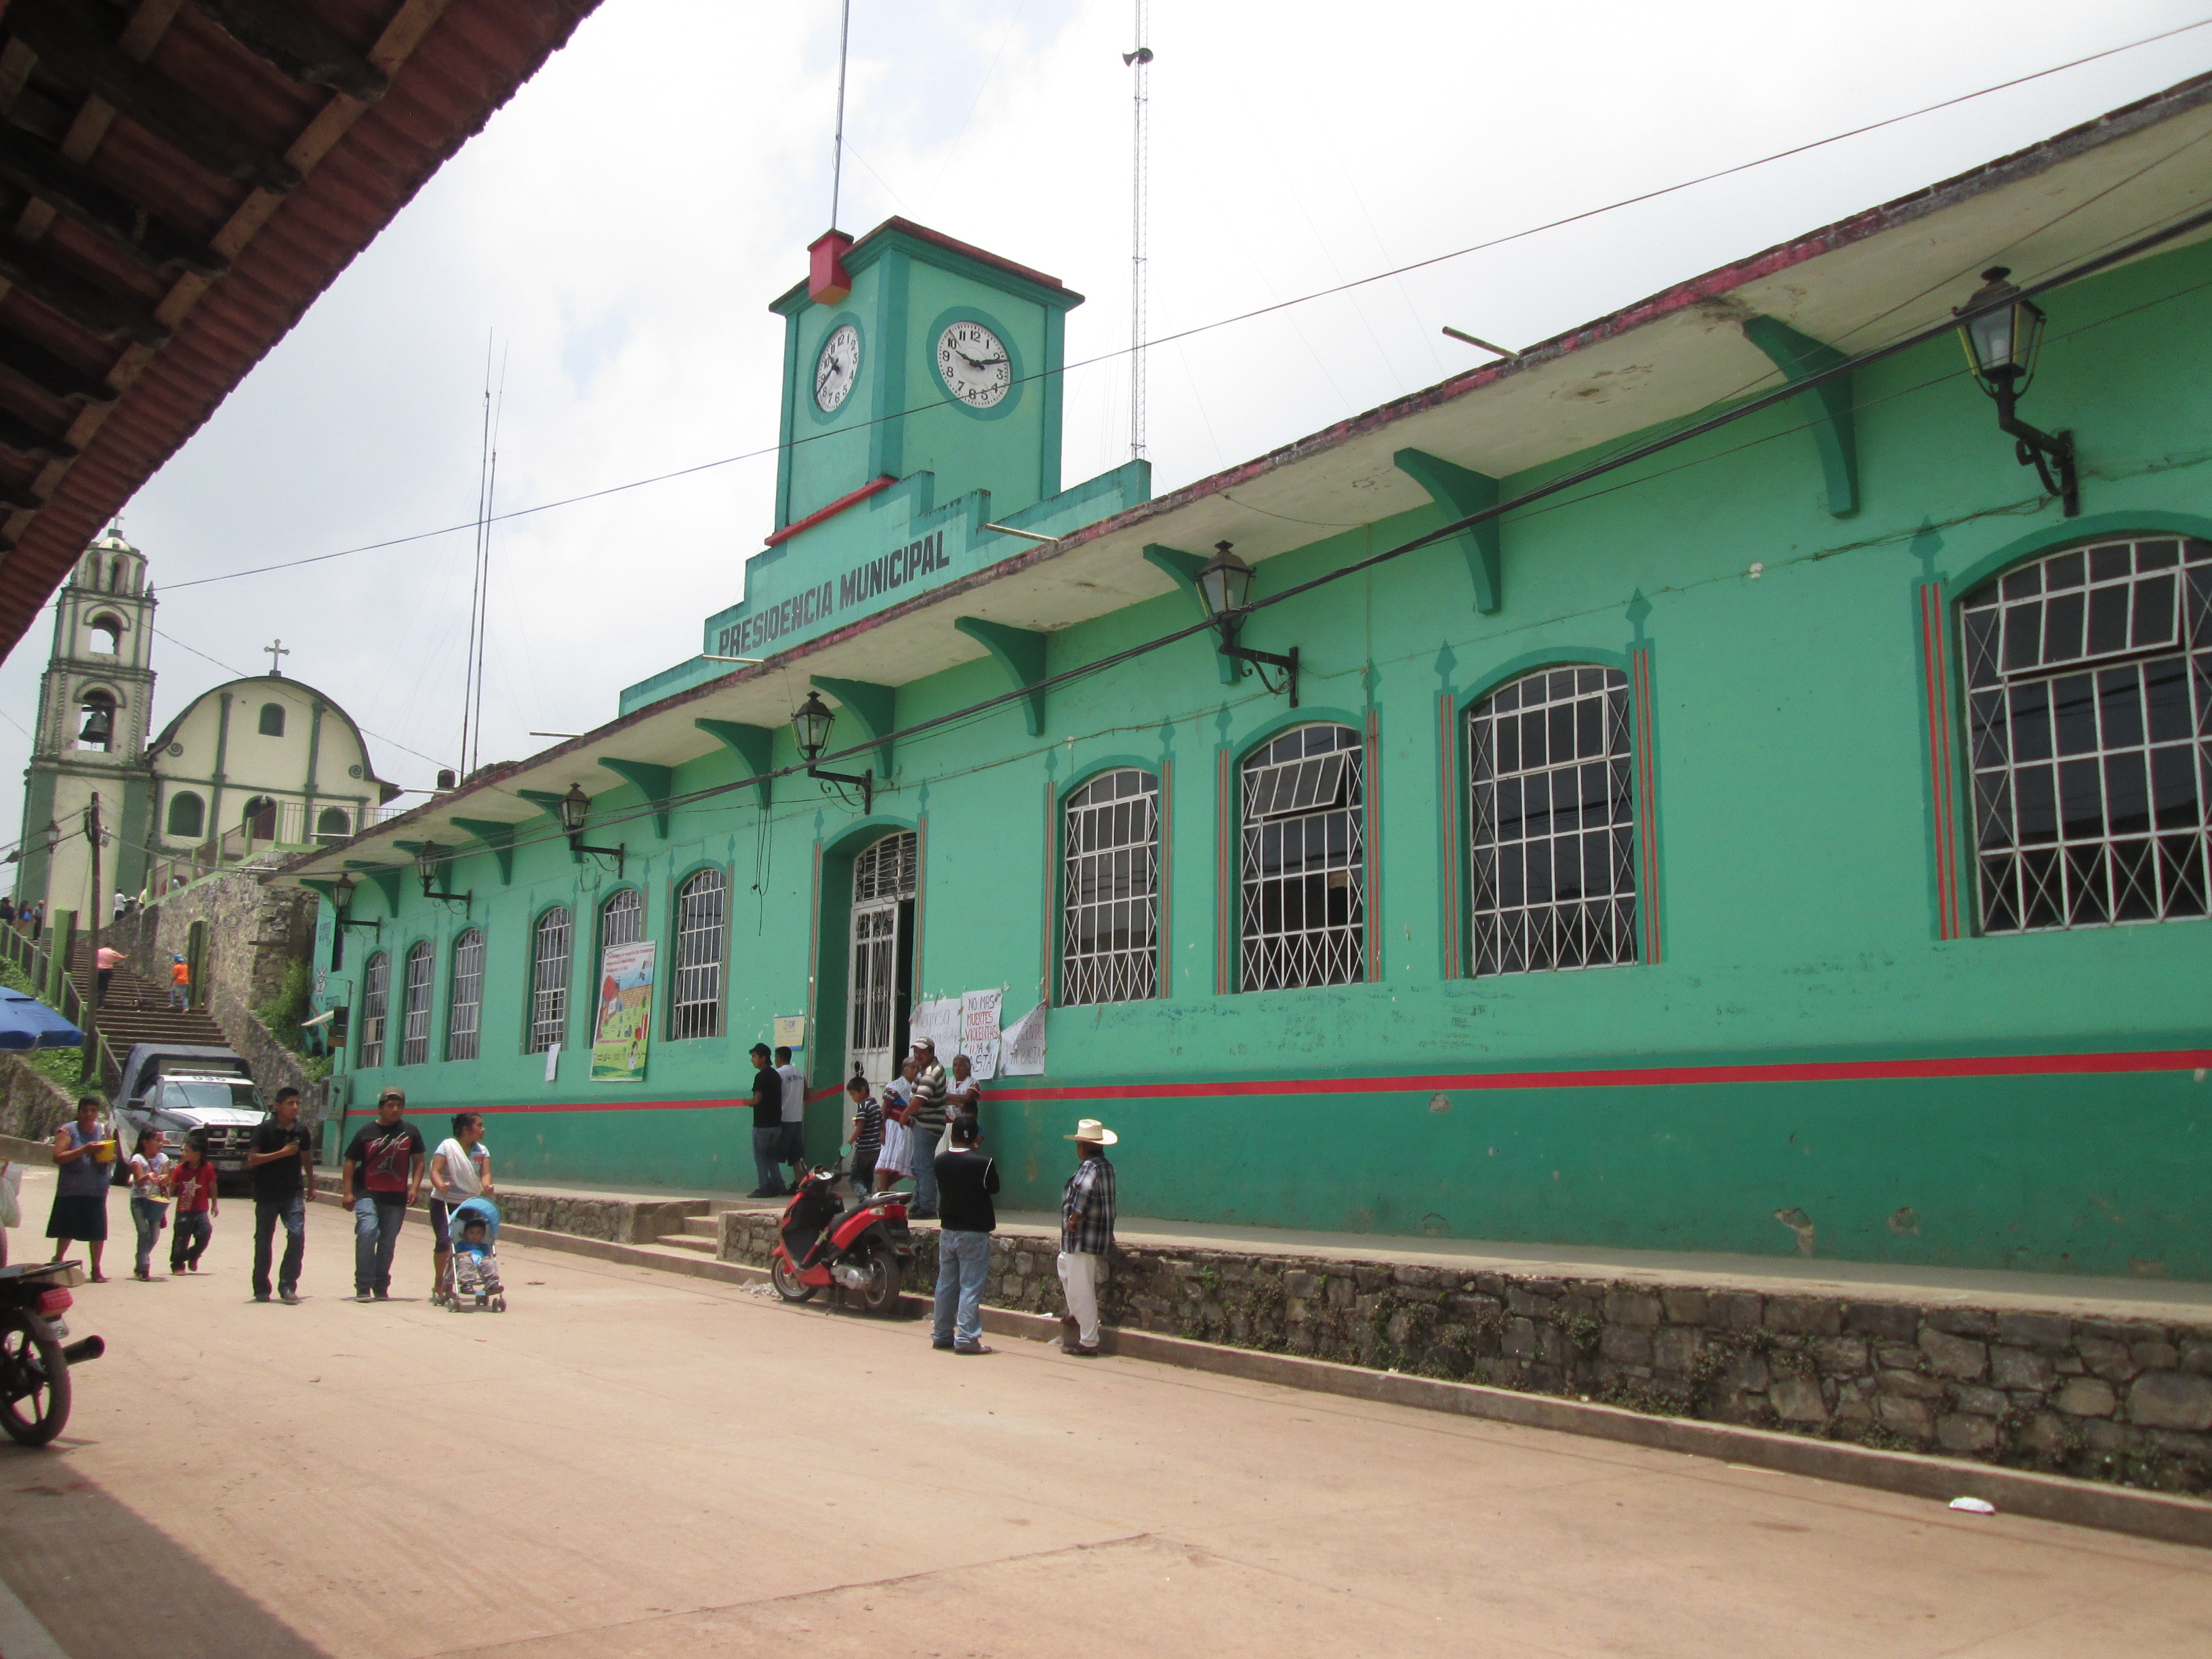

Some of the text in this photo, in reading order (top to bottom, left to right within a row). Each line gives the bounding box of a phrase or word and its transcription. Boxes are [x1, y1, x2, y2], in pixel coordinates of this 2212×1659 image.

[837, 335, 844, 347] 12
[847, 333, 850, 344] 1
[959, 330, 966, 341] 11
[970, 330, 980, 342] 12
[831, 343, 835, 354] 11
[851, 340, 856, 351] 2
[947, 337, 957, 349] 10
[986, 340, 989, 349] 1
[853, 352, 857, 364] 3
[942, 350, 950, 361] 9
[824, 359, 830, 369] 10
[849, 370, 854, 380] 4
[946, 367, 954, 377] 8
[996, 369, 1003, 380] 3
[842, 385, 847, 396] 5
[957, 380, 965, 391] 7
[991, 383, 998, 393] 4
[822, 386, 827, 397] 8
[969, 389, 976, 399] 6
[981, 390, 988, 400] 5
[828, 392, 833, 403] 7
[835, 392, 839, 403] 6
[719, 530, 950, 658] PRESIDENCIA MUNICIPAL
[968, 995, 995, 1010] NO MAS
[966, 1011, 994, 1027] MUERTES
[965, 1025, 999, 1042] VIOLENTAS
